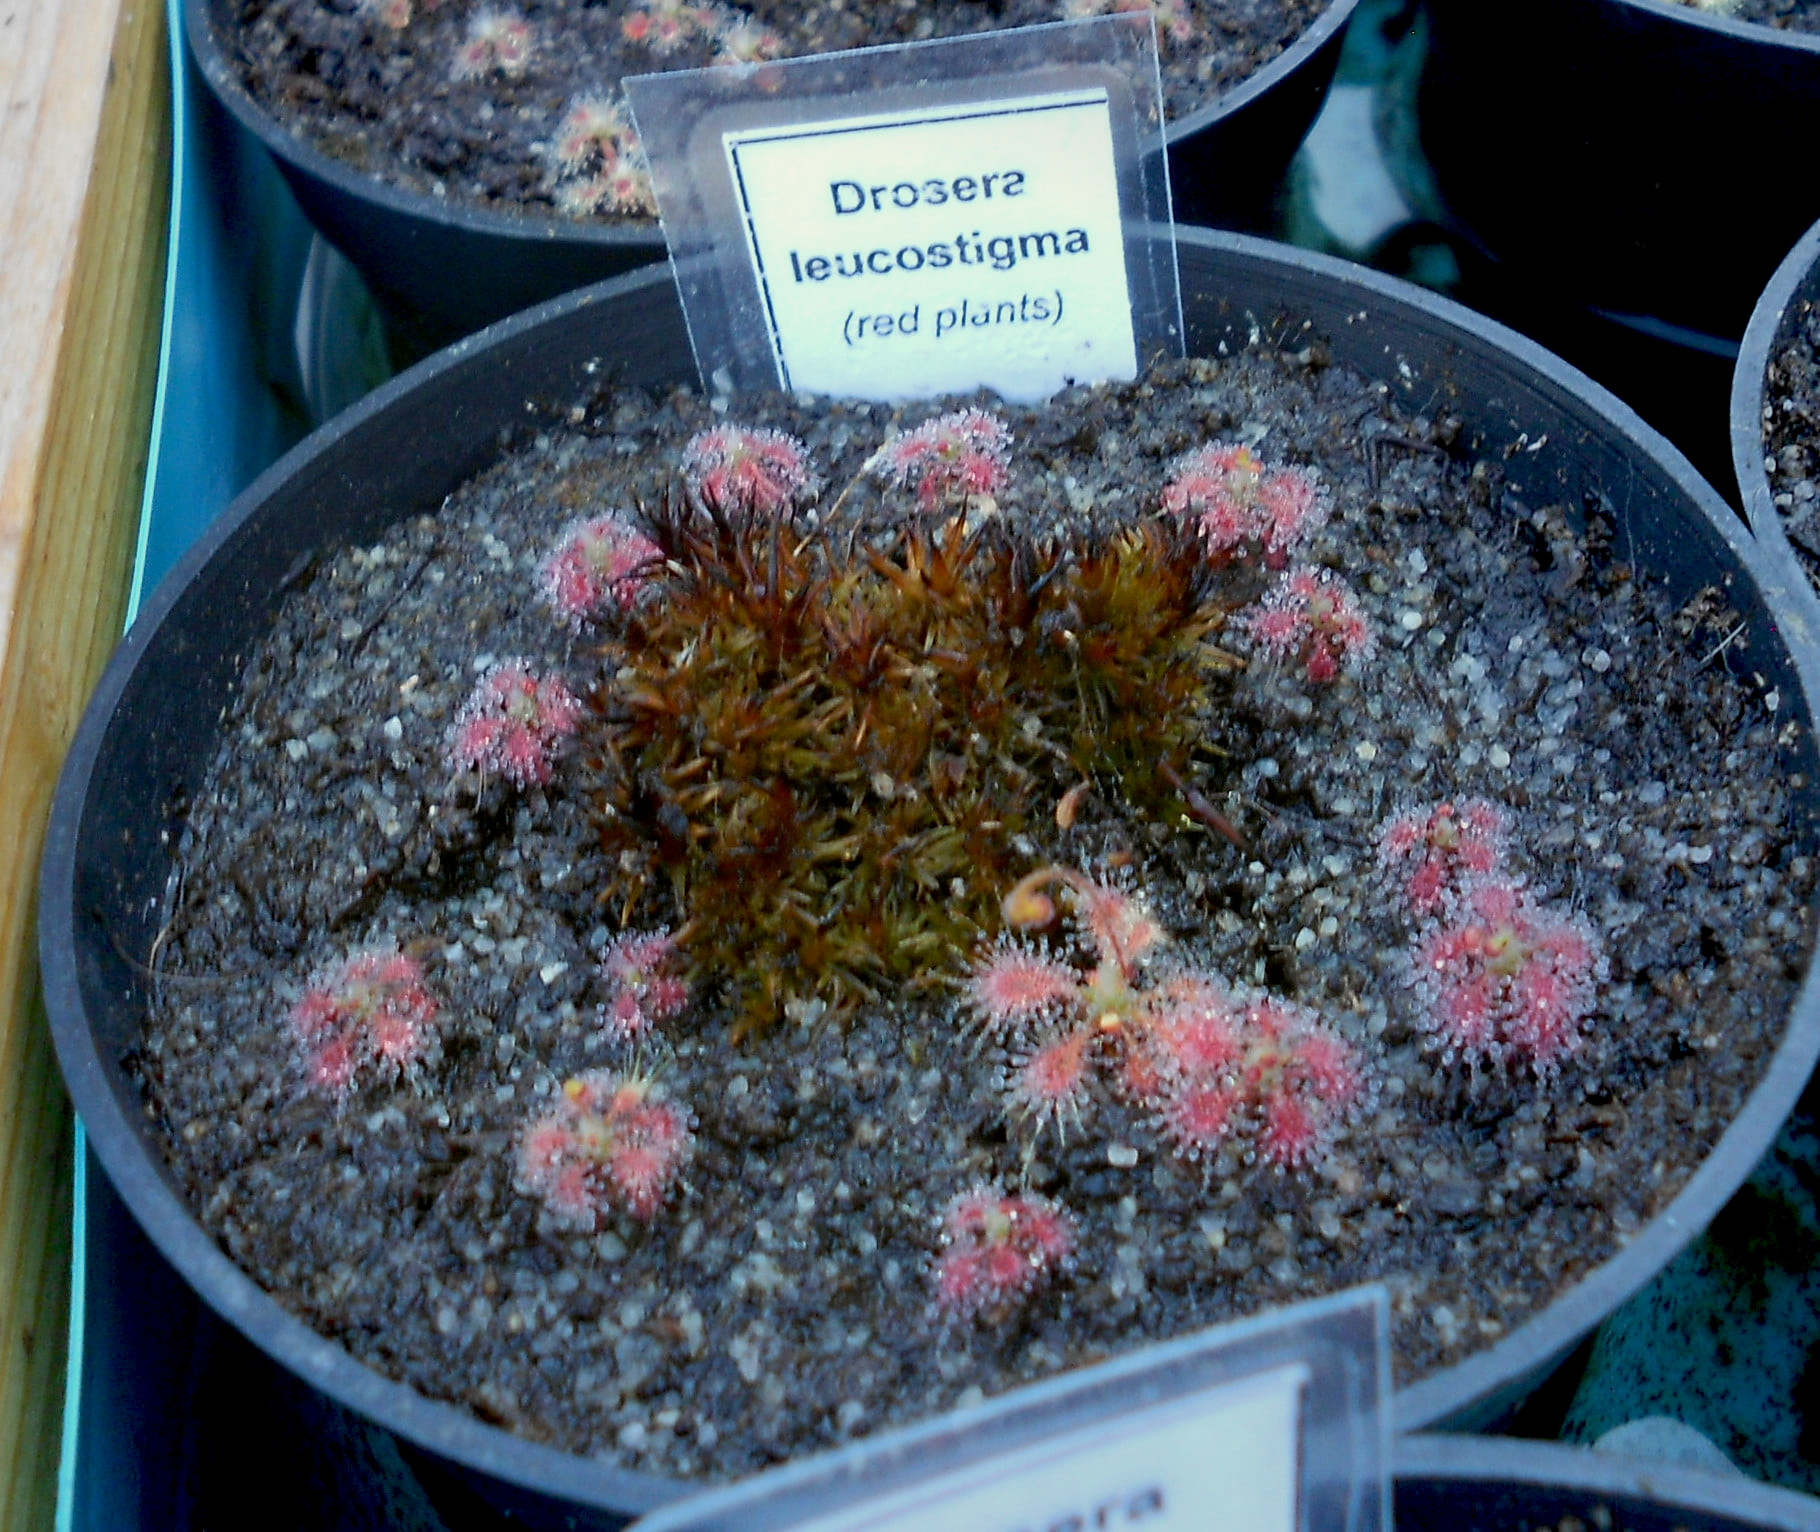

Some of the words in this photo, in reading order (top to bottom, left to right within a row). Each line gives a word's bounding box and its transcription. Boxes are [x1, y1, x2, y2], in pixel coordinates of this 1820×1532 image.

[829, 169, 1026, 216] Drosera
[789, 227, 1090, 284] leucostigma
[842, 301, 920, 346] (red
[935, 290, 1064, 339] plants)
